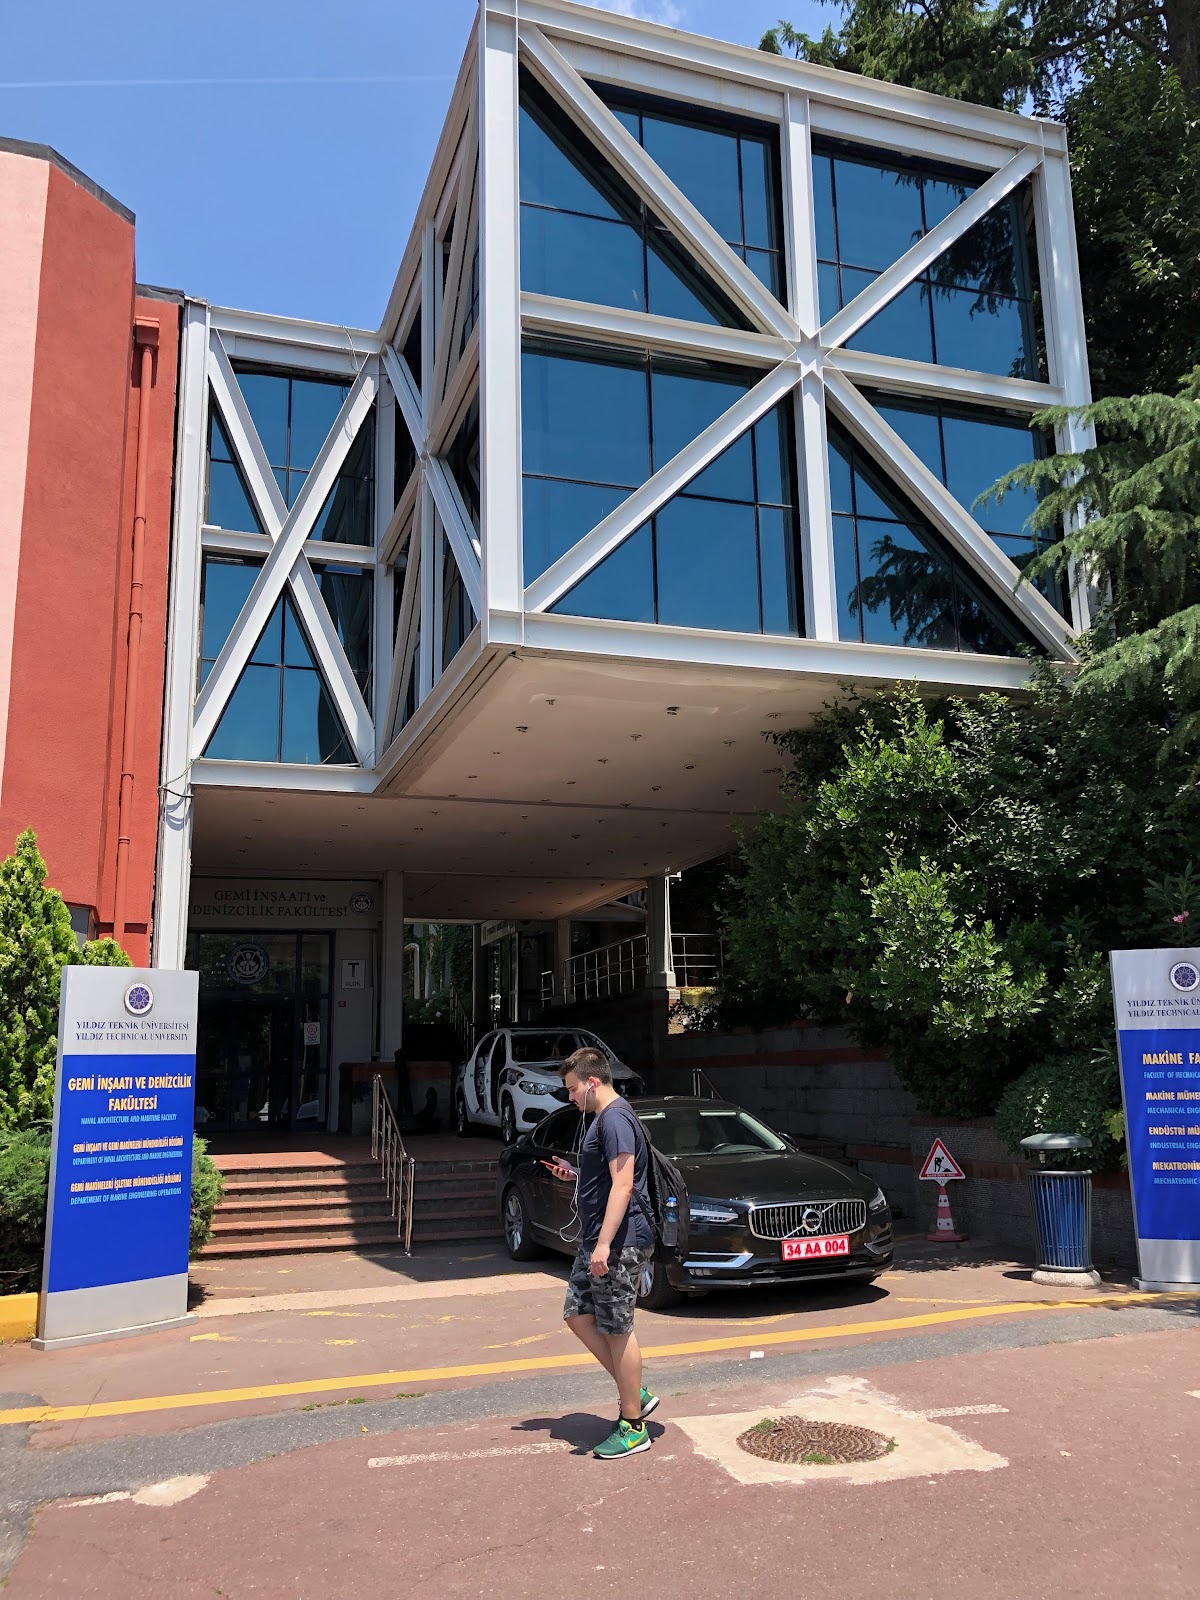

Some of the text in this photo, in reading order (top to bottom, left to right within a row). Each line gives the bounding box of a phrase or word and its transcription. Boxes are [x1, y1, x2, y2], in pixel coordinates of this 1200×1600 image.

[214, 888, 326, 903] GEMİ İNŞAATI ve
[192, 903, 347, 917] DENİZCİLİK FAKÜLTESİ
[348, 962, 359, 977] T
[1157, 998, 1189, 1007] TEKNİK
[1156, 1009, 1200, 1017] TECHNICAL
[77, 1020, 189, 1030] YILDIZ TEKNİK ÜNİVERSİTESİ
[76, 1033, 188, 1041] YILDIZ TECHNICAL UNIVERSITY
[1142, 1050, 1183, 1065] MAKİNE
[1144, 1071, 1165, 1079] FACULTY
[68, 1073, 192, 1093] GEMİ İNŞAATI VE DENİZCİLİK
[1145, 1090, 1175, 1100] MAKİNE
[108, 1095, 158, 1111] FAKÜLTESİ
[1148, 1124, 1185, 1136] ENDÜSTRİ
[1154, 1177, 1198, 1185] MECHATRONIC
[787, 1240, 845, 1256] 34 AA 004
